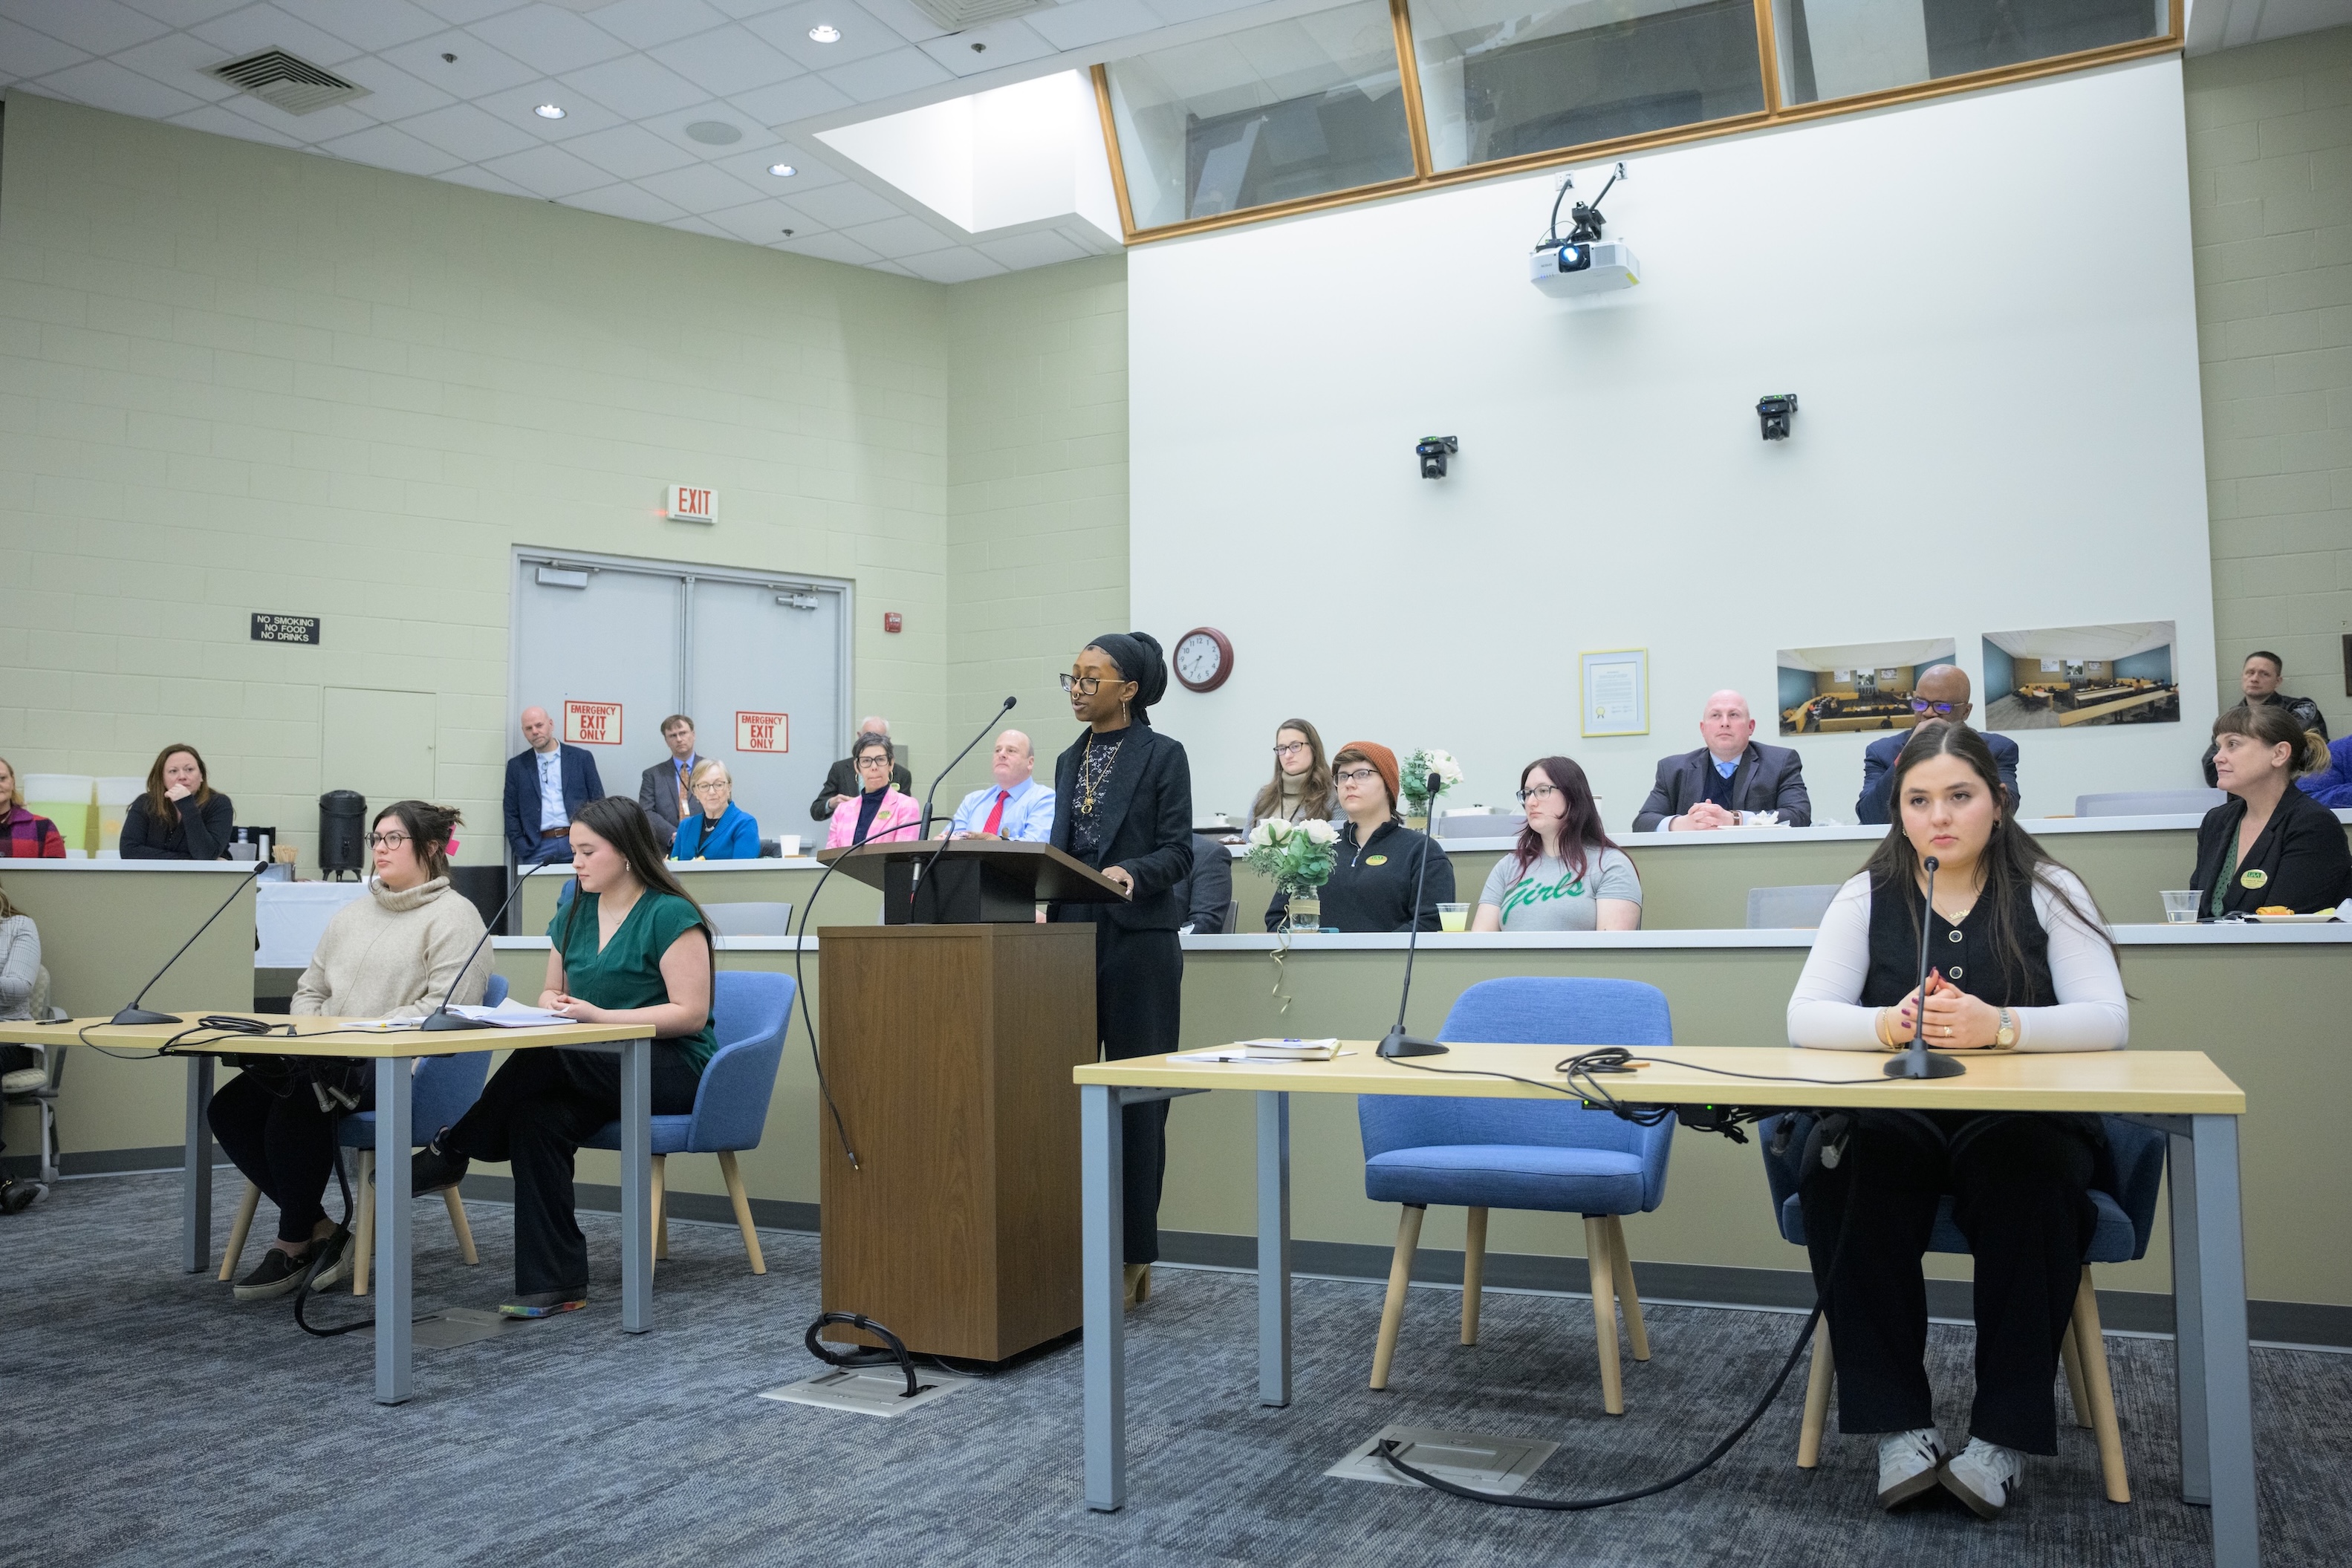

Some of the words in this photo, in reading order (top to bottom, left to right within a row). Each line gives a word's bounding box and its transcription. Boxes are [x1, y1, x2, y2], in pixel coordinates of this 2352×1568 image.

[679, 487, 711, 515] EXIT
[257, 615, 270, 624] NO
[274, 617, 314, 627] SMOKING
[264, 624, 278, 632] NO
[281, 625, 306, 634] FOOD
[261, 631, 274, 640] NO
[277, 632, 309, 642] DRINKS
[571, 704, 616, 715] EMERGENCY
[580, 715, 606, 729] EXIT
[741, 715, 783, 725] EMERGENCY
[579, 729, 606, 741] ONLY
[750, 724, 774, 738] EXIT
[750, 738, 774, 749] ONLY
[1500, 871, 1585, 925] Girls
